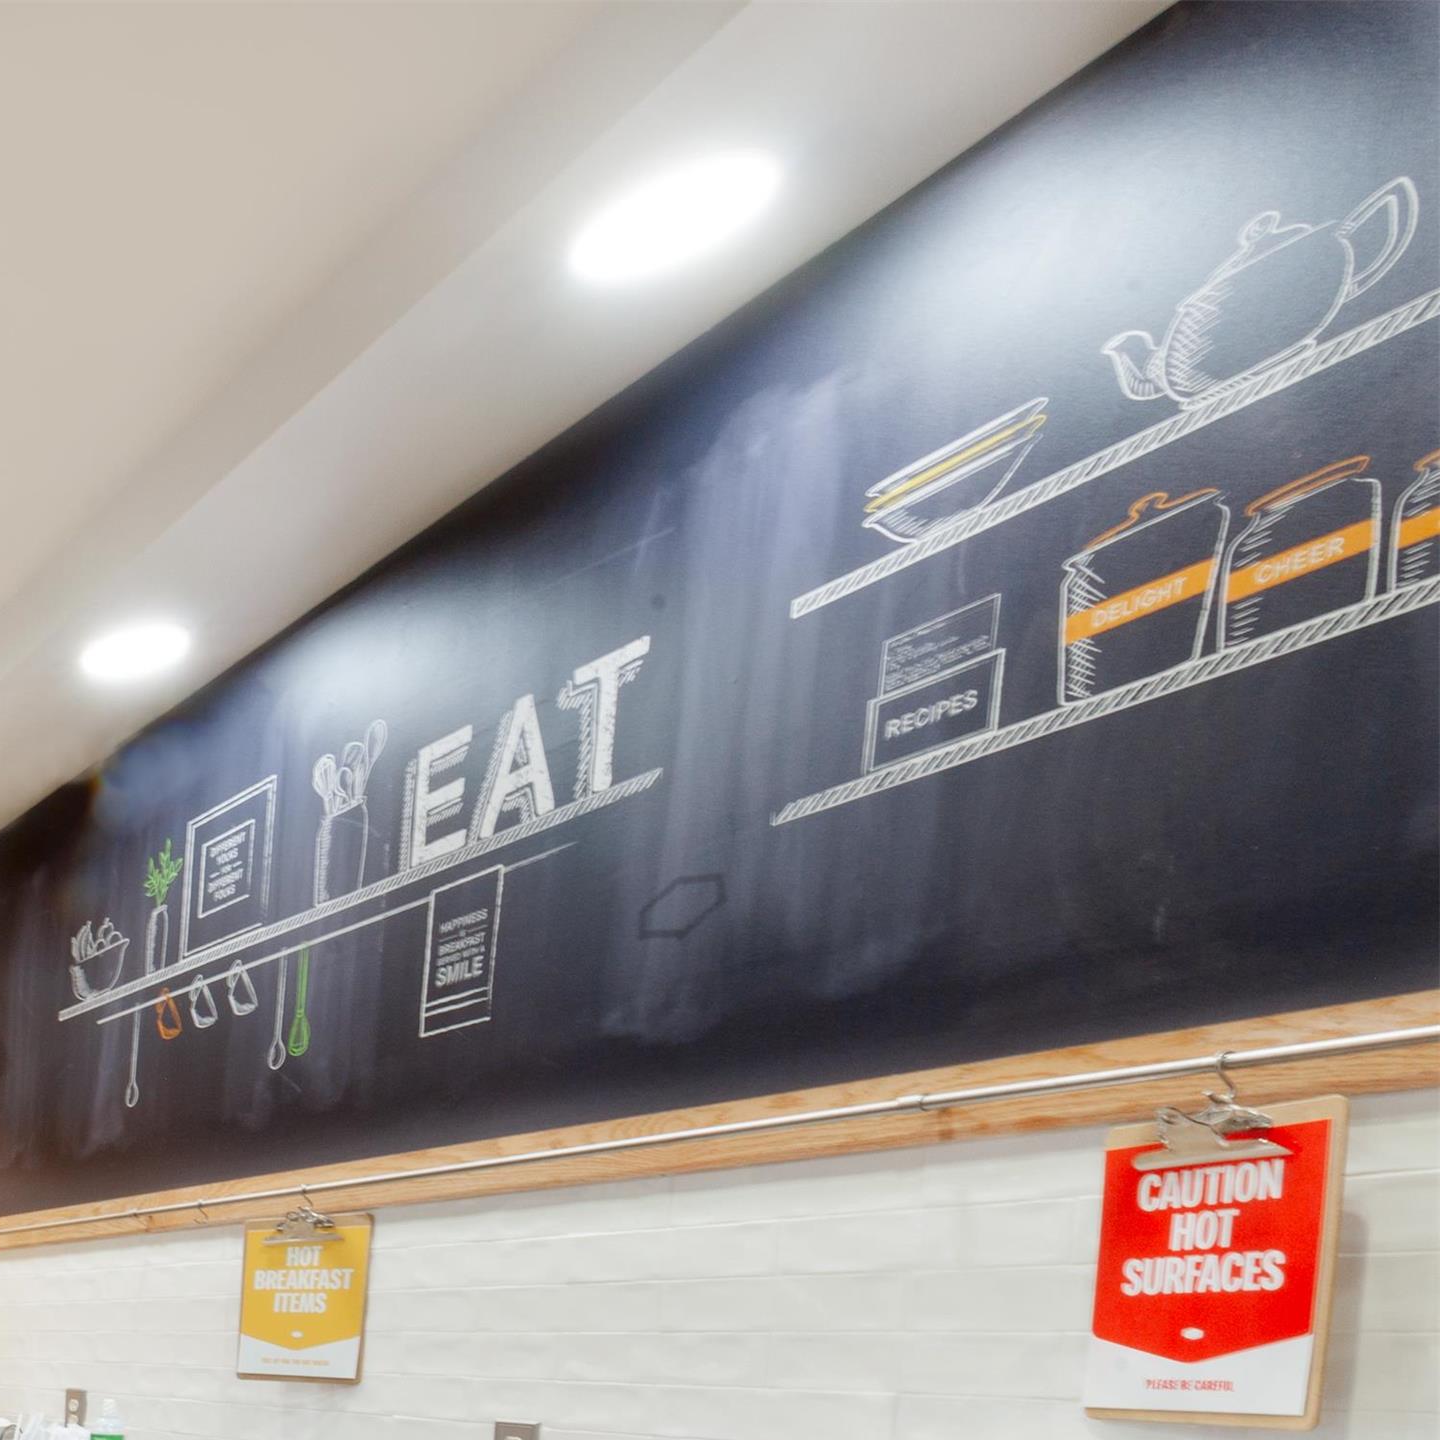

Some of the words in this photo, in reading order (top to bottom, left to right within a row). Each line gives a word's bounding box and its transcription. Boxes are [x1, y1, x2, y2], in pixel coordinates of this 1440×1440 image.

[1255, 537, 1345, 584] CHEER
[1090, 576, 1187, 628] DELIGHT
[884, 689, 978, 740] RECIPES
[404, 635, 651, 868] EAT
[435, 955, 484, 987] SMILE
[1137, 1158, 1286, 1212] CAUTION
[1169, 1208, 1240, 1251] HOT
[254, 1268, 354, 1290] BREAKFAST
[286, 1246, 323, 1267] HOT
[1121, 1249, 1287, 1297] SURFACES
[273, 1292, 327, 1313] ITEMS
